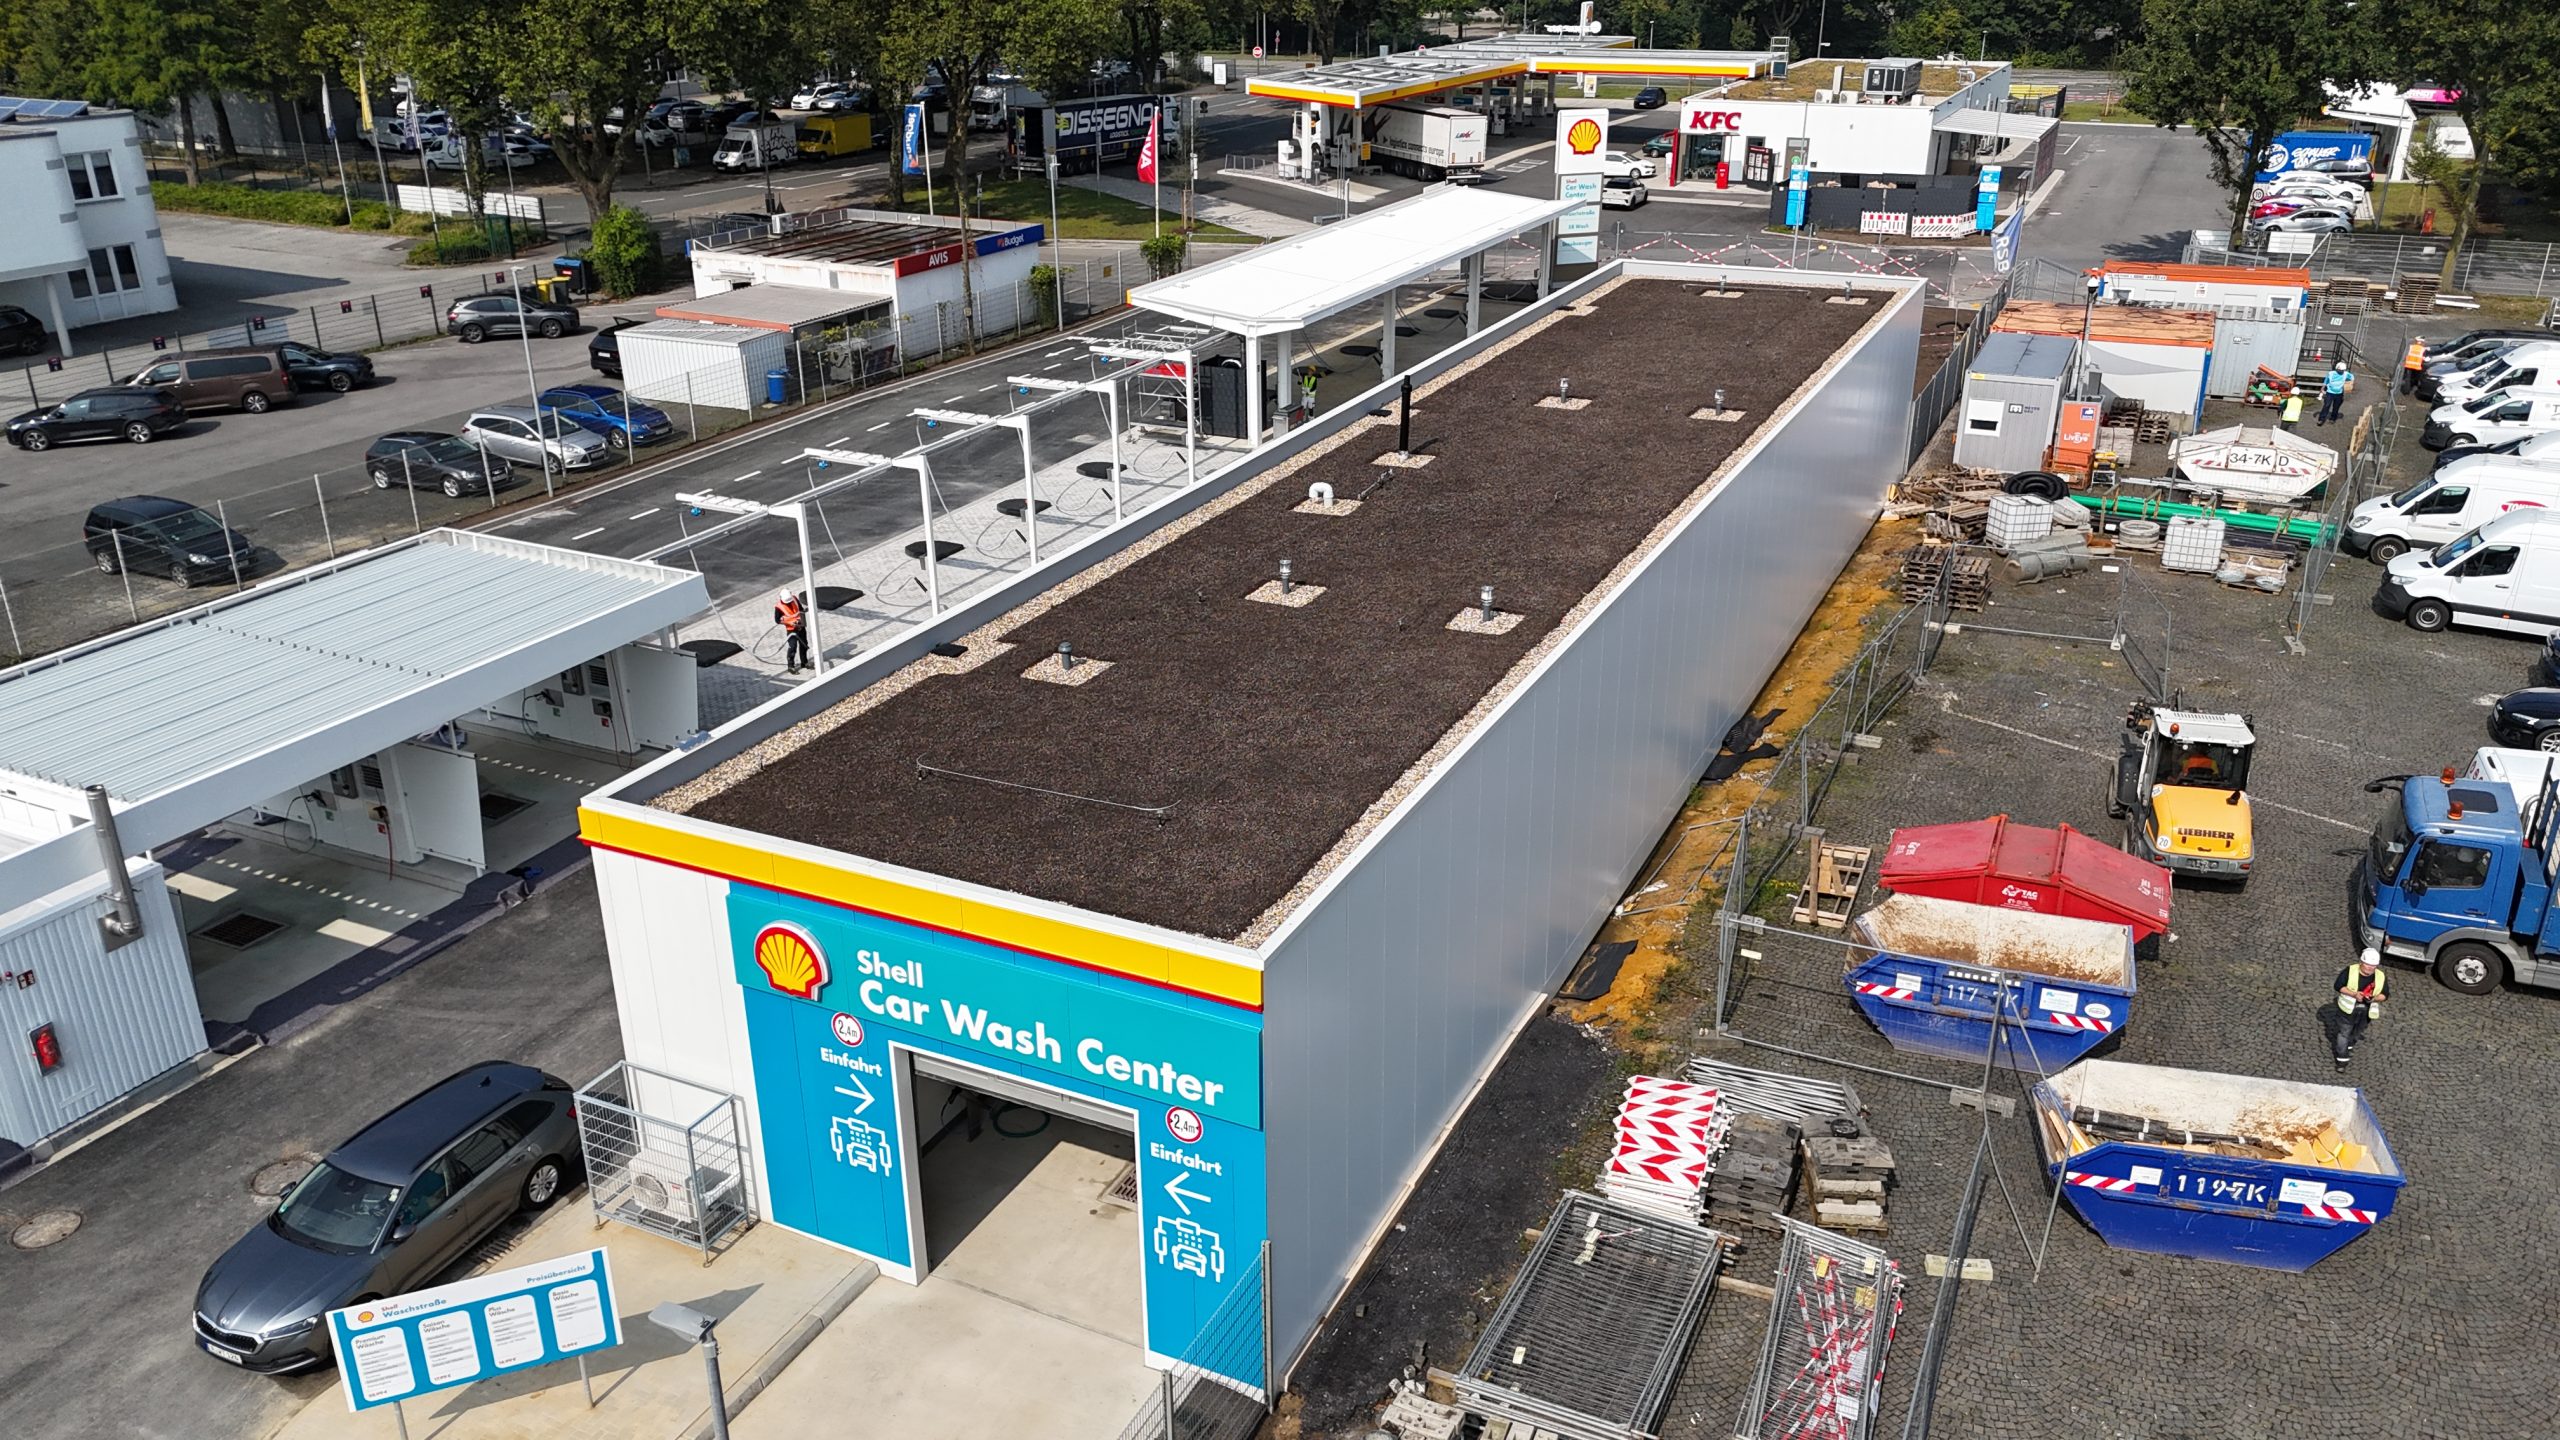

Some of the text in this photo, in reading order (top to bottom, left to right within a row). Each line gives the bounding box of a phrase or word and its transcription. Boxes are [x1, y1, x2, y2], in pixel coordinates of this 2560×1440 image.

[1058, 102, 1154, 137] DISSEGNA
[1690, 111, 1742, 131] KFC
[1004, 233, 1025, 248] Budget
[928, 250, 949, 268] AVIS
[1995, 235, 2009, 273] RSB
[2230, 452, 2289, 467] 34-7K D
[2159, 837, 2169, 847] 20
[2177, 827, 2235, 840] LIEBHERR
[857, 949, 924, 988] Shell
[860, 979, 1224, 1107] Car Wash Center
[820, 1047, 883, 1078] Einfahrt
[1150, 1142, 1223, 1177] Einfahrt
[526, 1264, 587, 1284] Preisübersicht
[382, 1298, 447, 1318] Waschstraße
[355, 1334, 386, 1345] Premium
